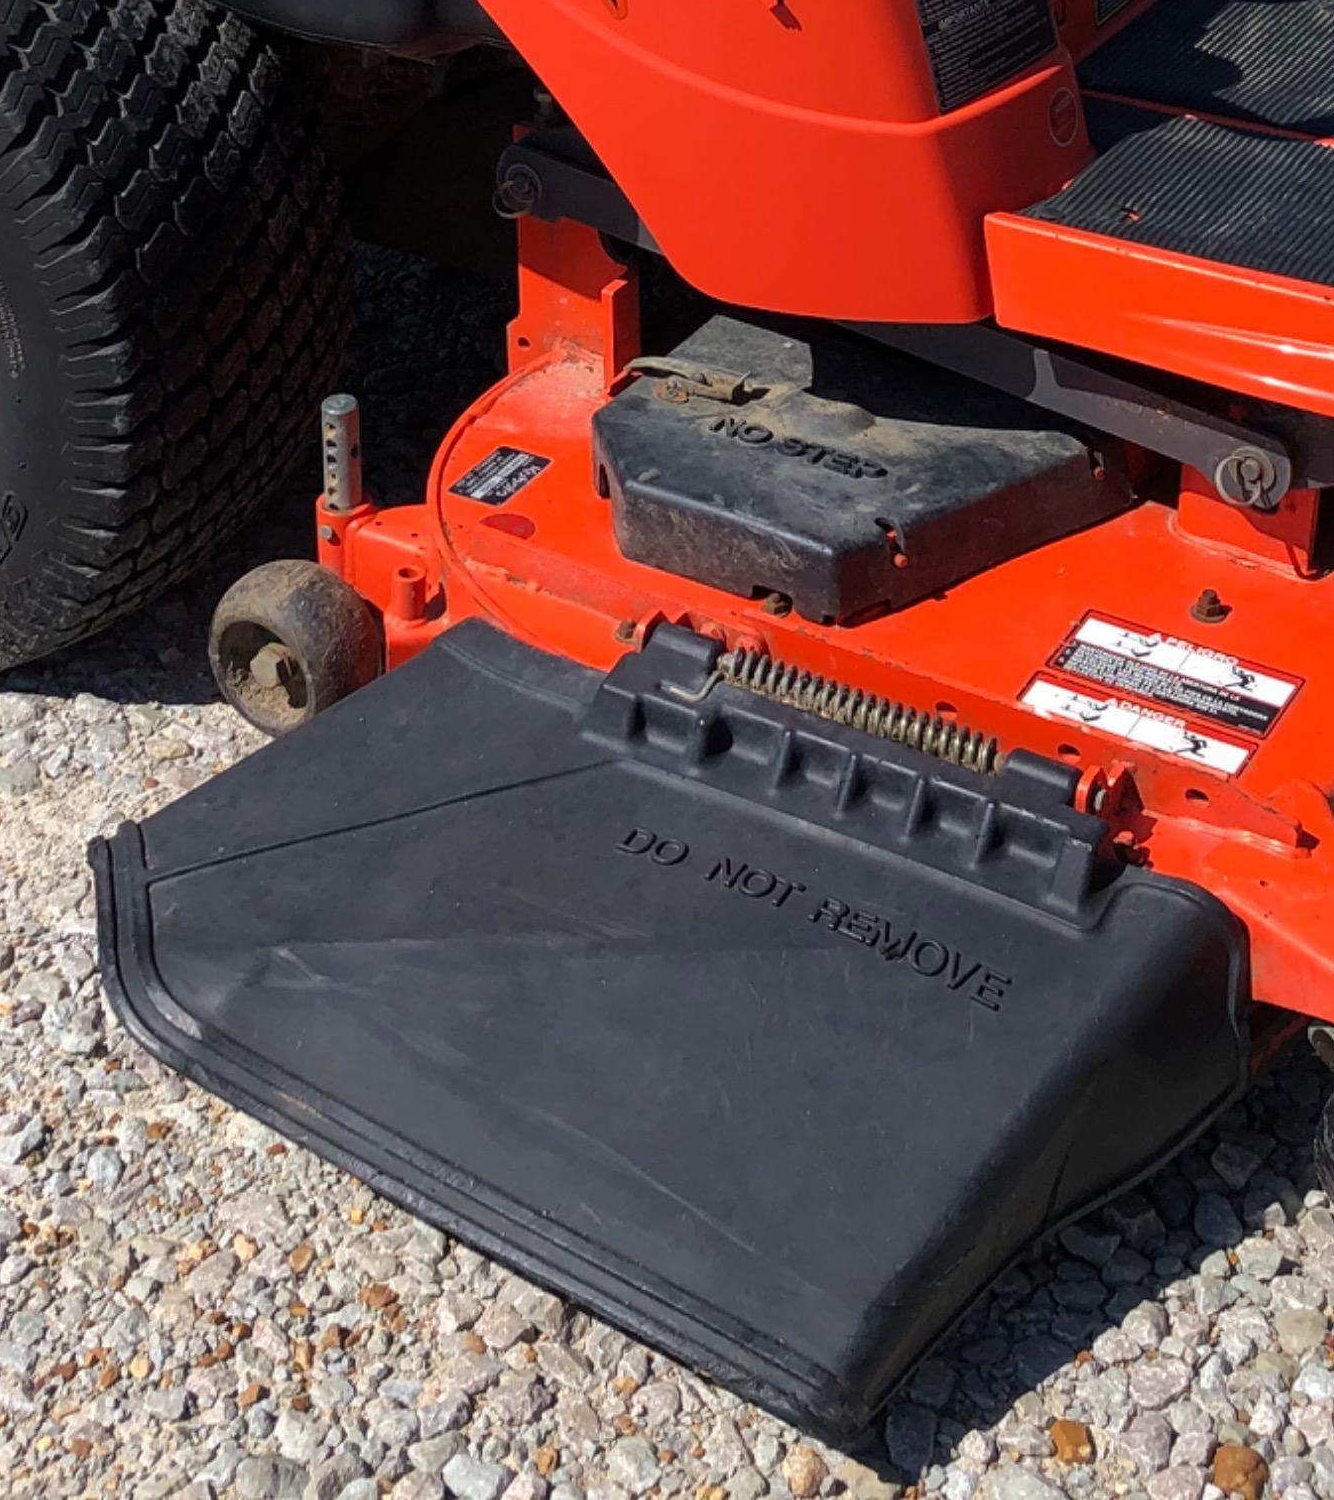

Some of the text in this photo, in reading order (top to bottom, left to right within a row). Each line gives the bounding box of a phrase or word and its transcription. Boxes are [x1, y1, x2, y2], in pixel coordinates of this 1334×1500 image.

[709, 417, 889, 479] NO STEP
[1165, 635, 1238, 666] PELIGRO
[1119, 700, 1188, 729] DANGER
[615, 826, 1013, 1013] DO NOT REMOVE
